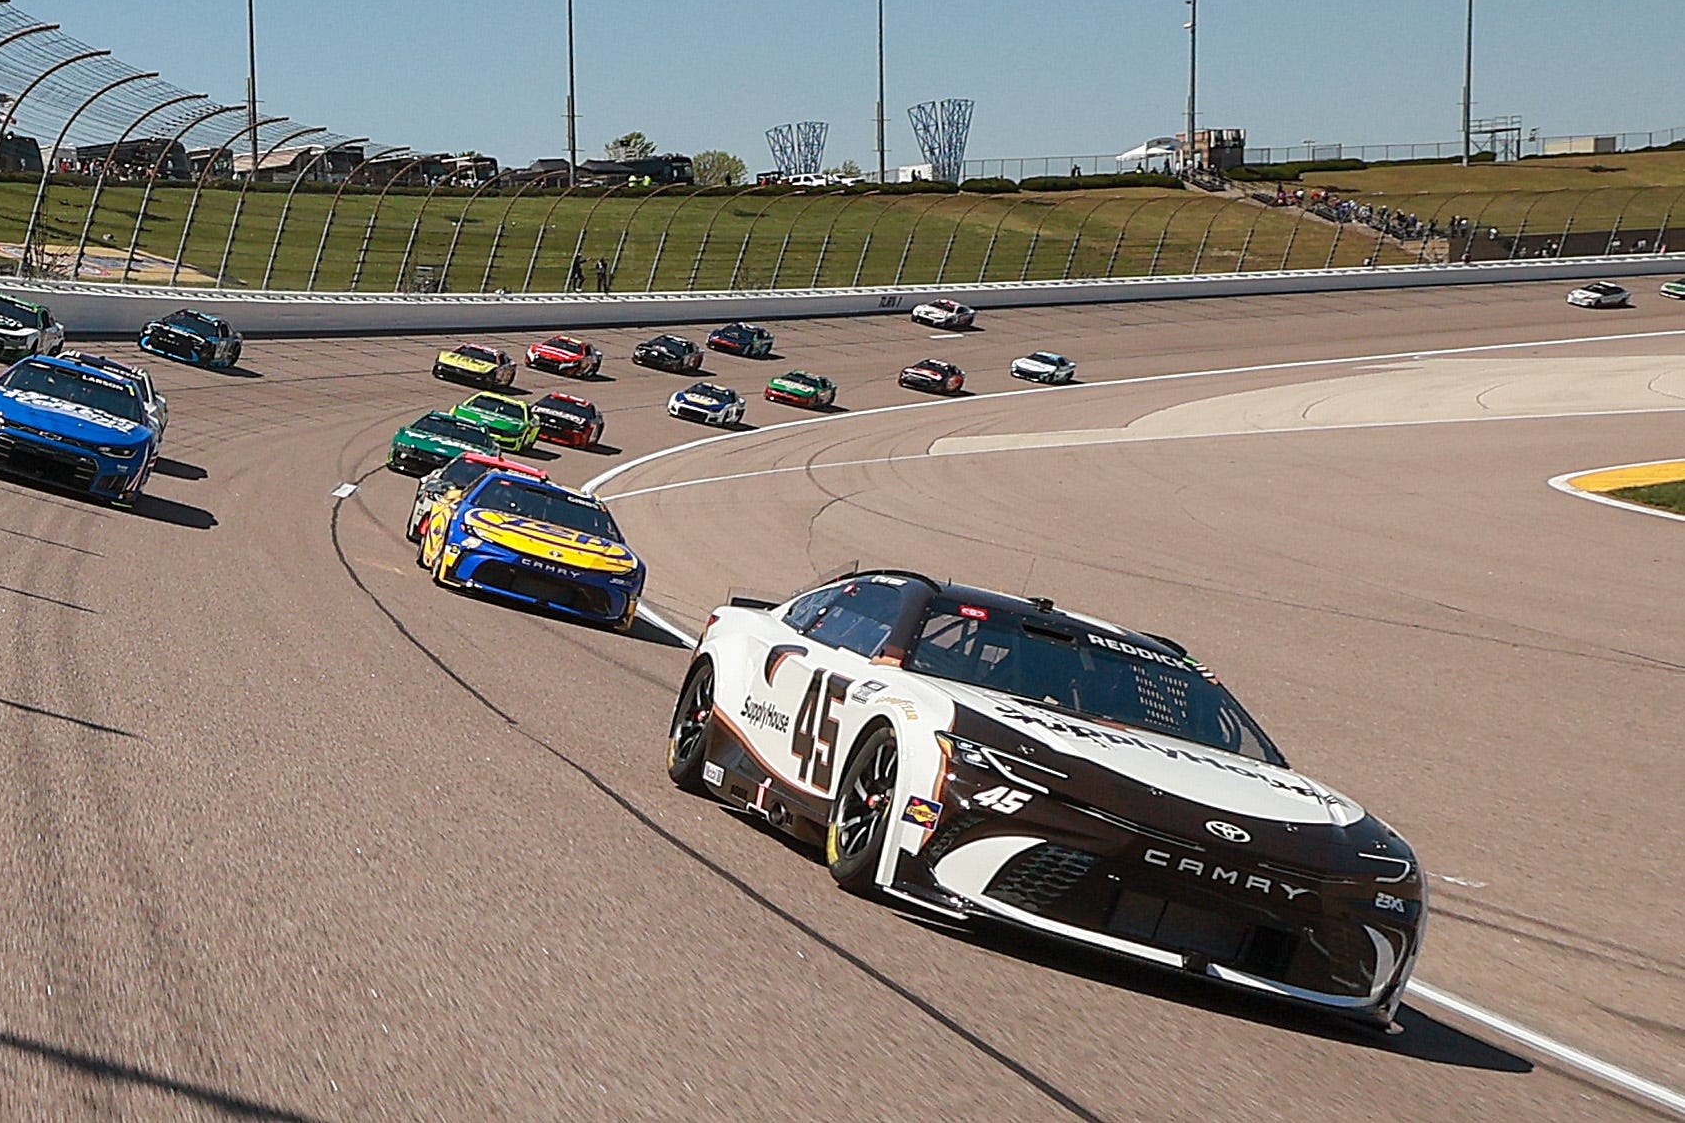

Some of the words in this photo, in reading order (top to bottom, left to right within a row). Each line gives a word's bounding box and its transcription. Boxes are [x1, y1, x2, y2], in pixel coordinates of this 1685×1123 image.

[82, 374, 124, 391] LARSON
[521, 558, 581, 578] CAMRY
[1087, 632, 1191, 672] REDDICK
[791, 666, 856, 795] 45
[972, 785, 1034, 815] 45
[1143, 848, 1311, 901] CAMRY
